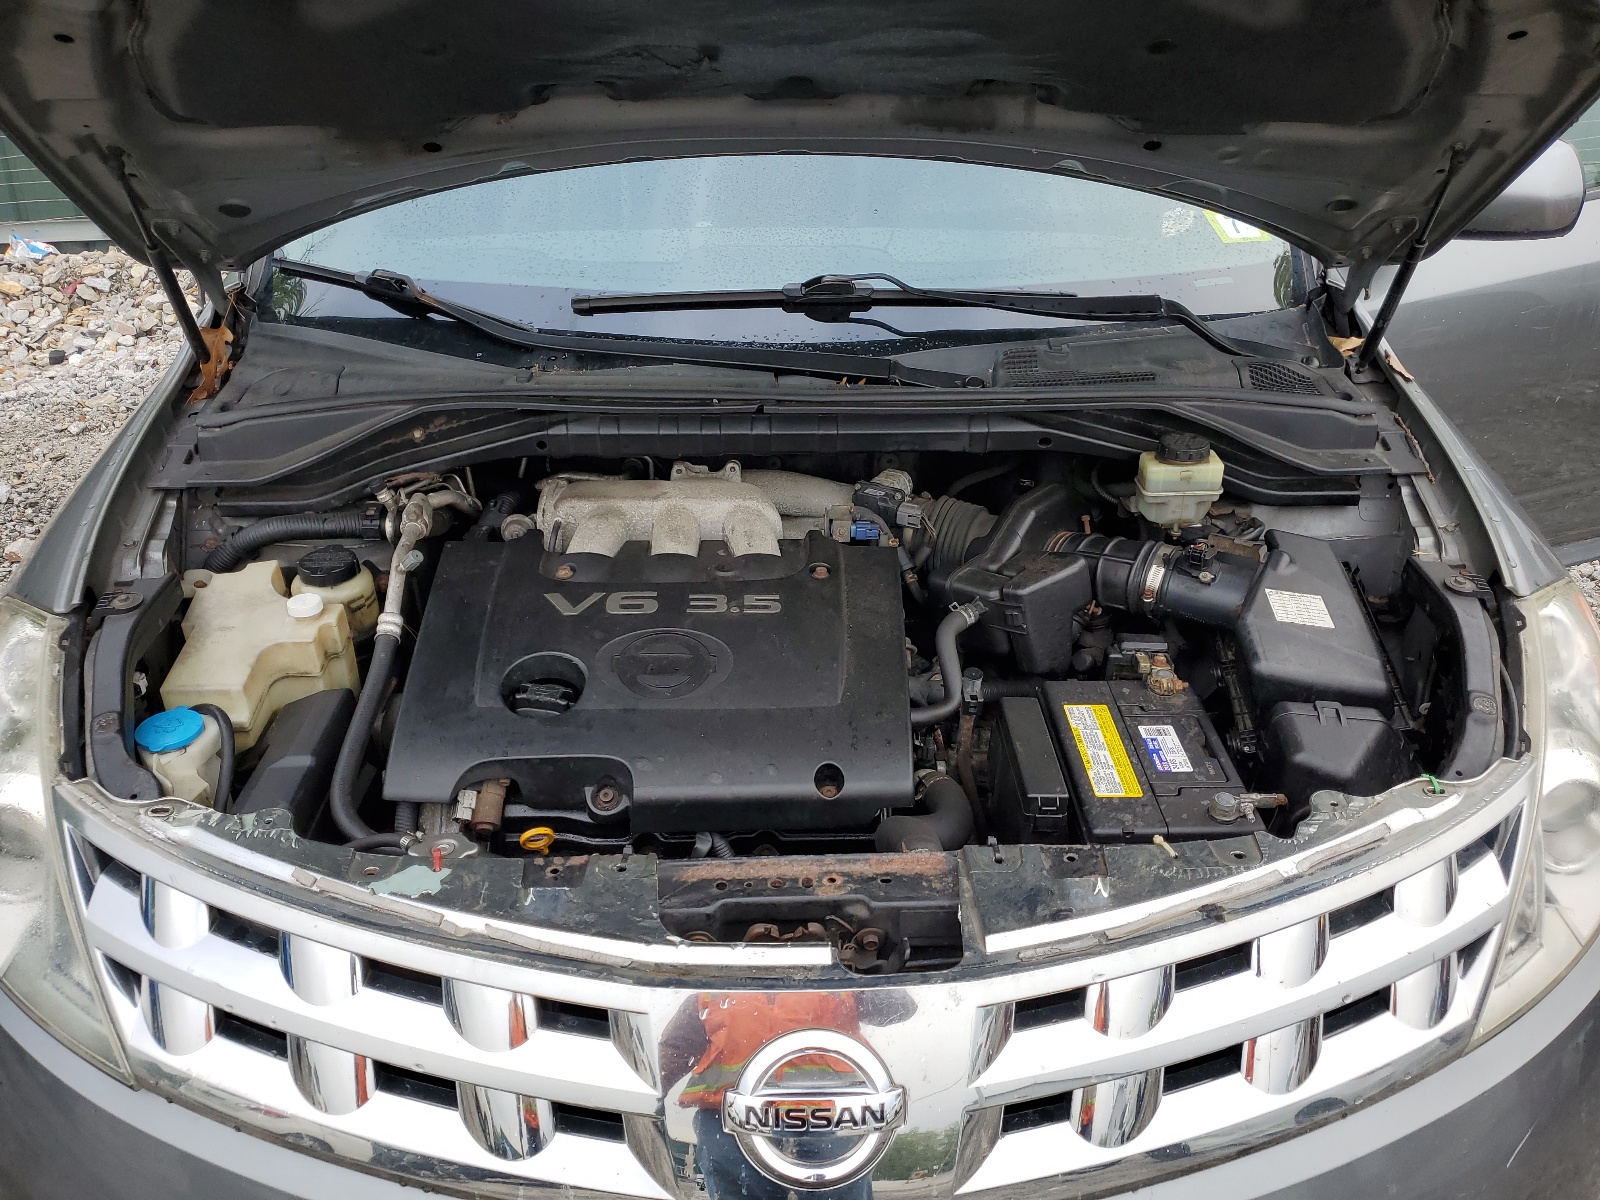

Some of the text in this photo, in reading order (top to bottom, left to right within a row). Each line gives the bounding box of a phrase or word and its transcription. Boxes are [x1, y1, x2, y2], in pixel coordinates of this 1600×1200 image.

[543, 591, 782, 616] V6 3.5
[744, 1102, 886, 1132] NISSAN
